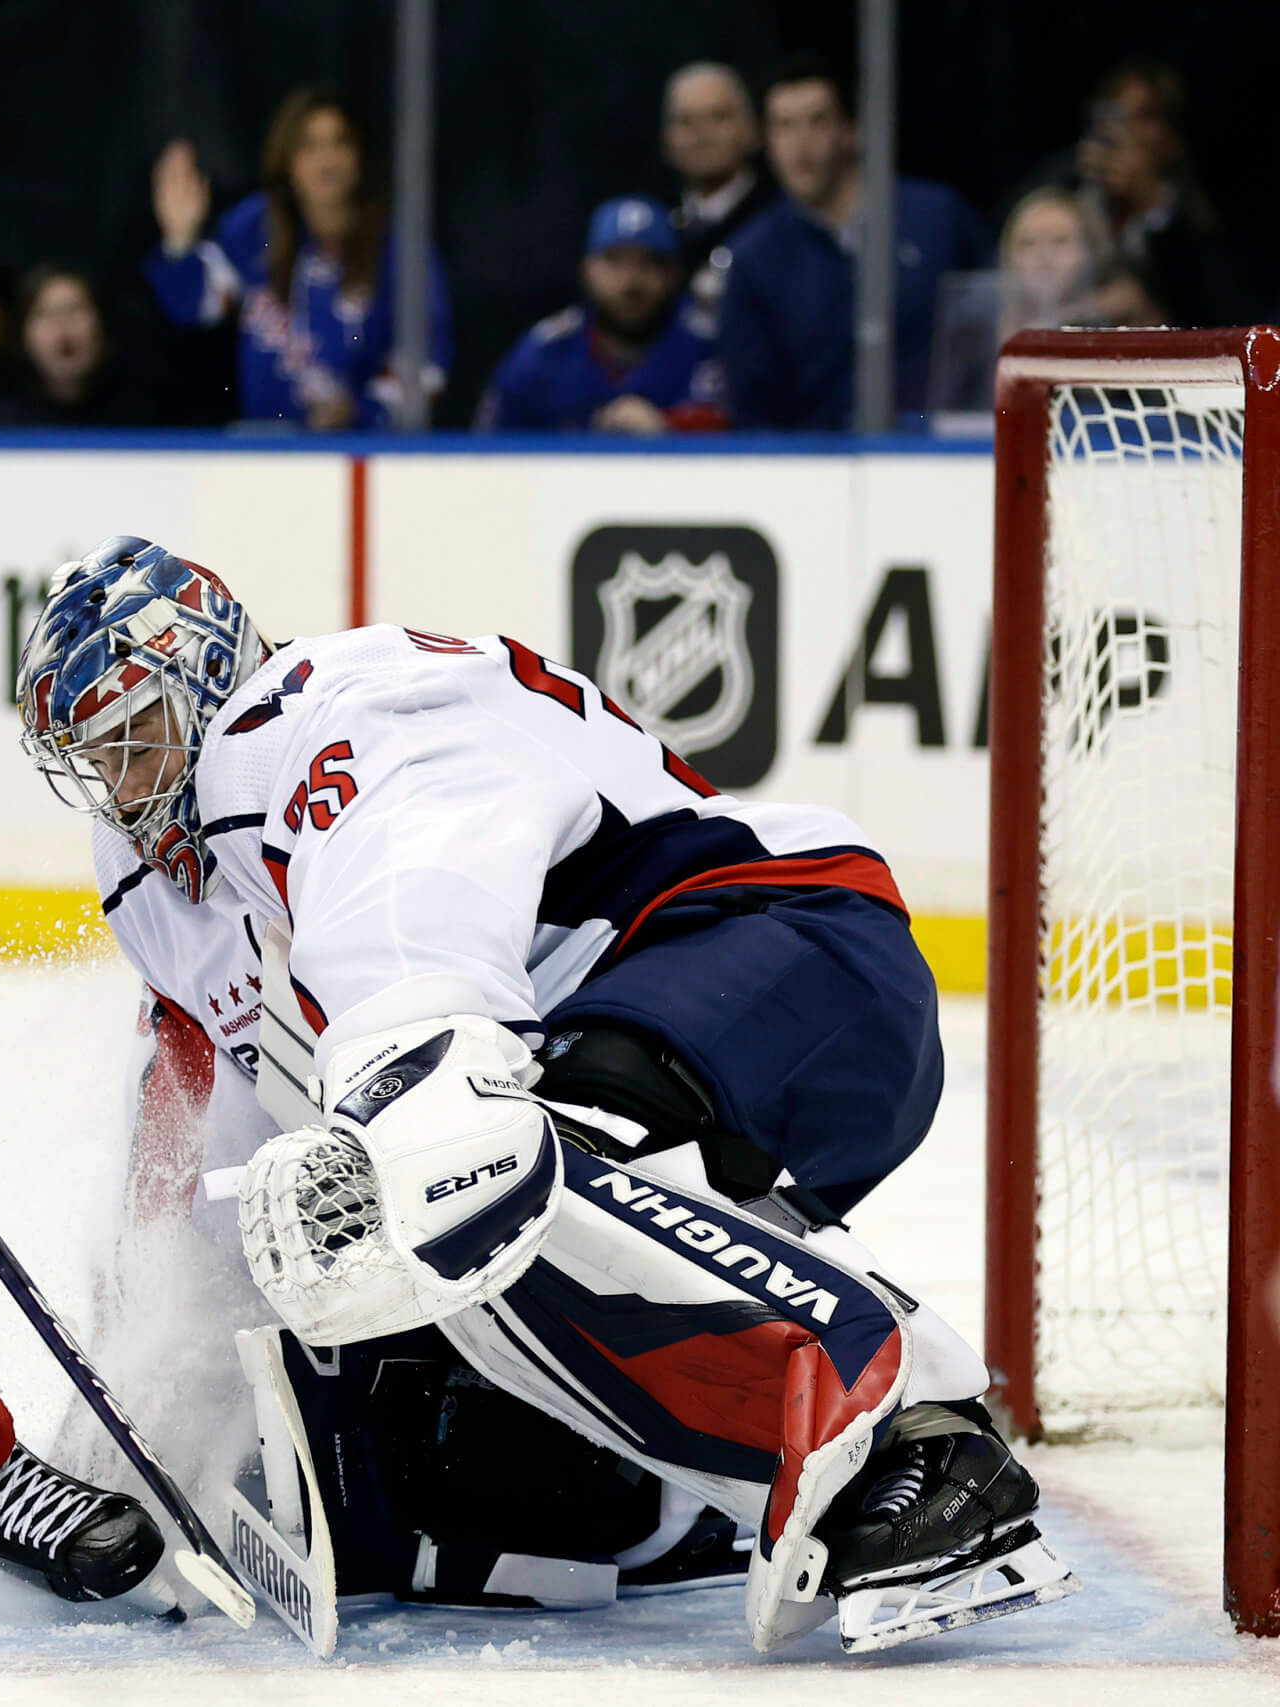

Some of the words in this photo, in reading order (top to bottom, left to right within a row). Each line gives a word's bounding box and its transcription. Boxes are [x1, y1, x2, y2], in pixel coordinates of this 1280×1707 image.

[812, 565, 1172, 758] AP
[482, 1076, 521, 1091] AUGHN
[425, 1155, 518, 1204] SLR3
[589, 1172, 840, 1325] VAUGHN
[232, 1508, 314, 1642] ARRIOR
